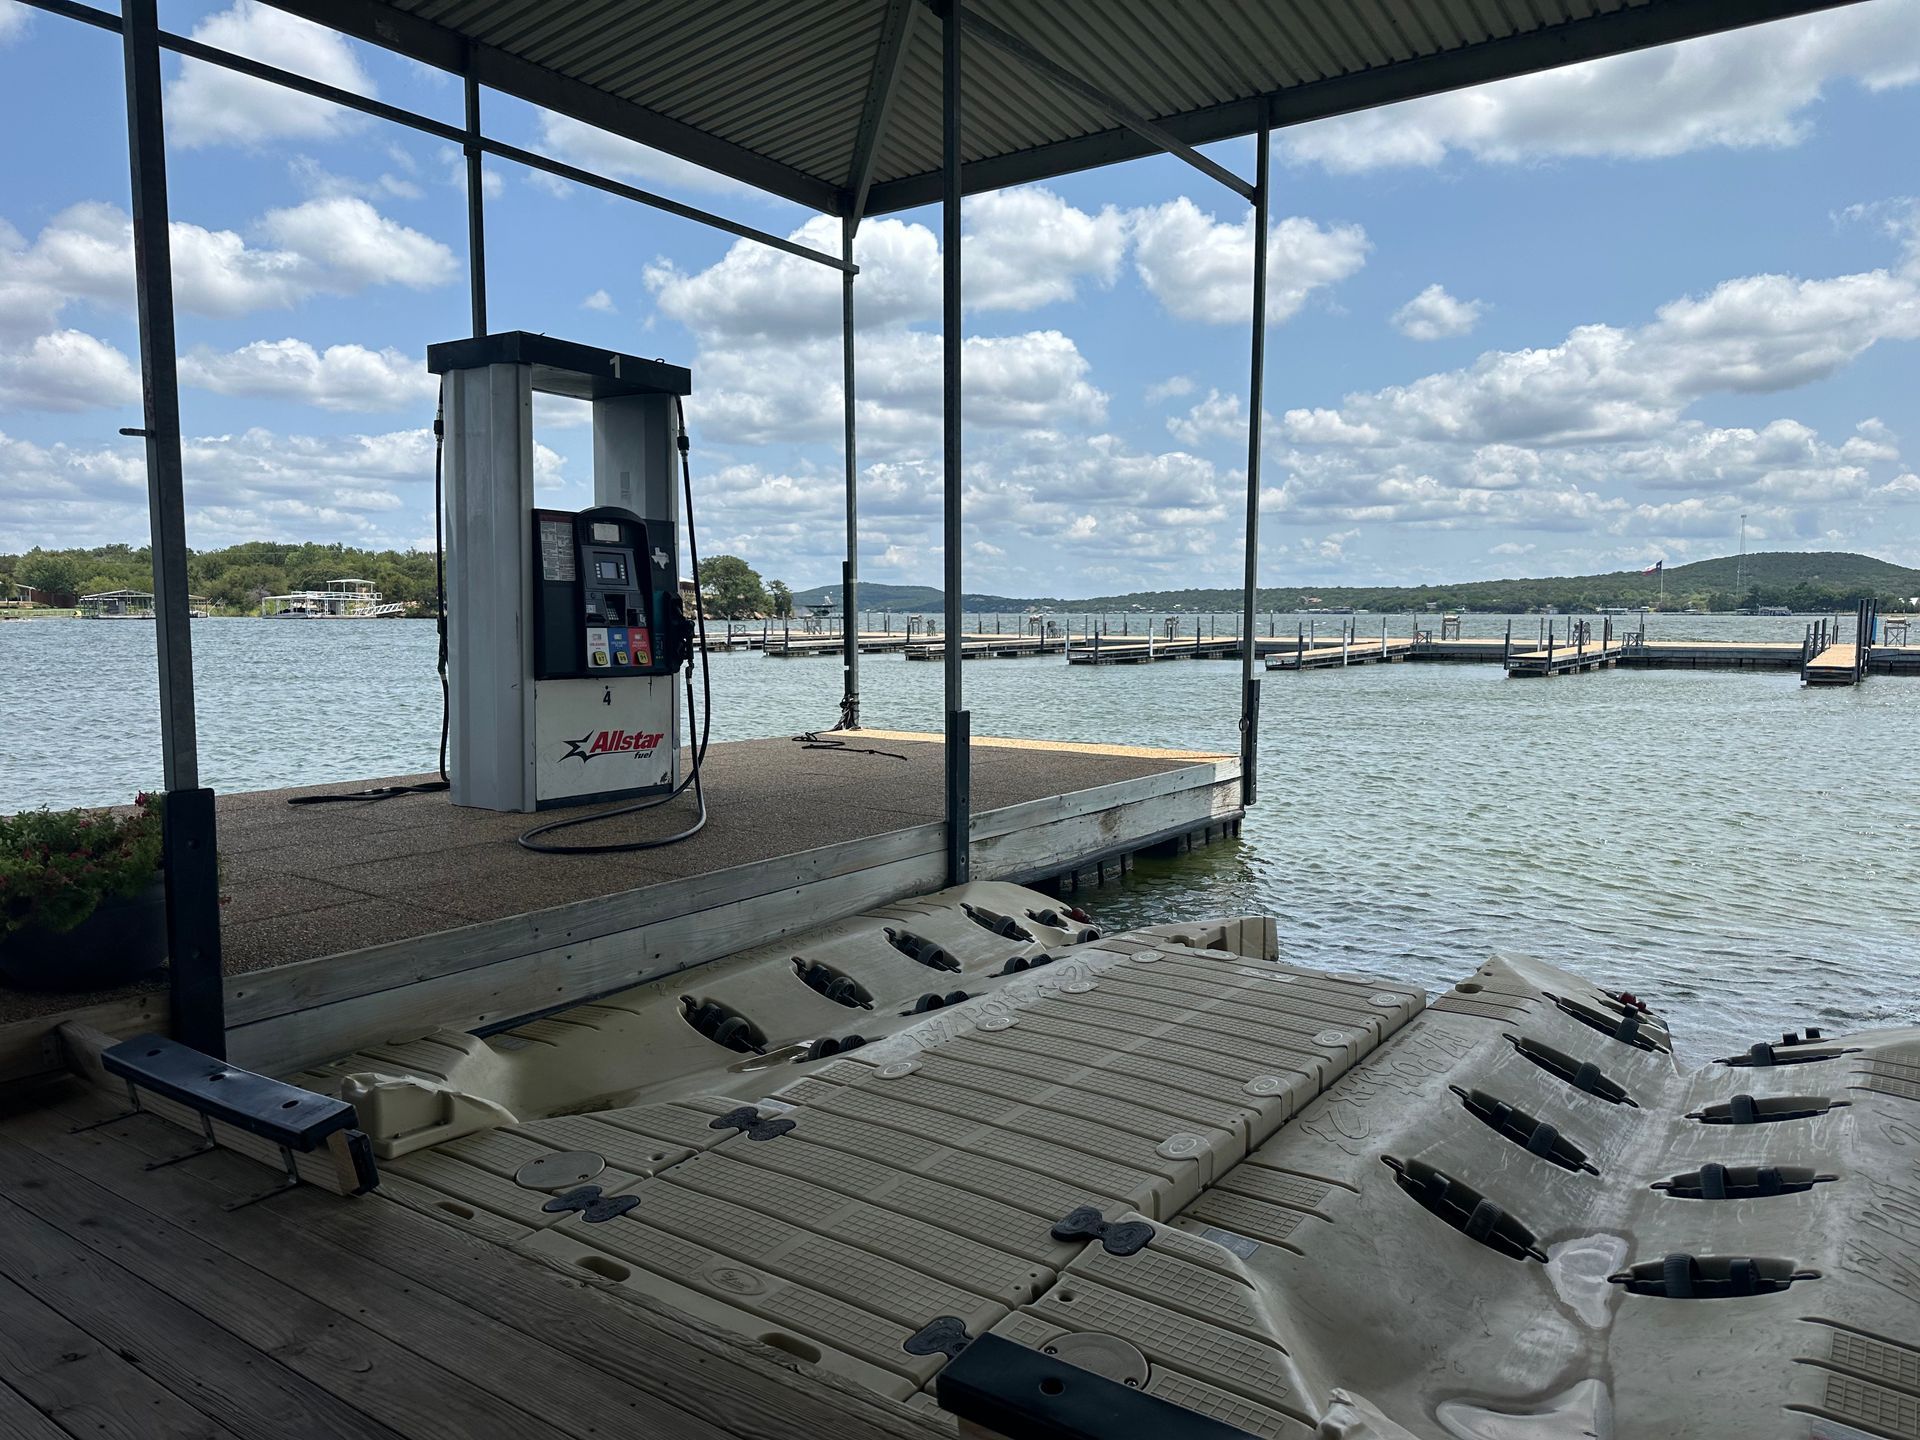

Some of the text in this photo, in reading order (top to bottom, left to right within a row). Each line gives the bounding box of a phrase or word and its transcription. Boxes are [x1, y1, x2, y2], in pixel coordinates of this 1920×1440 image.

[609, 354, 621, 379] 1
[603, 691, 611, 706] 4
[589, 729, 664, 753] Allstar
[634, 750, 653, 759] fuel
